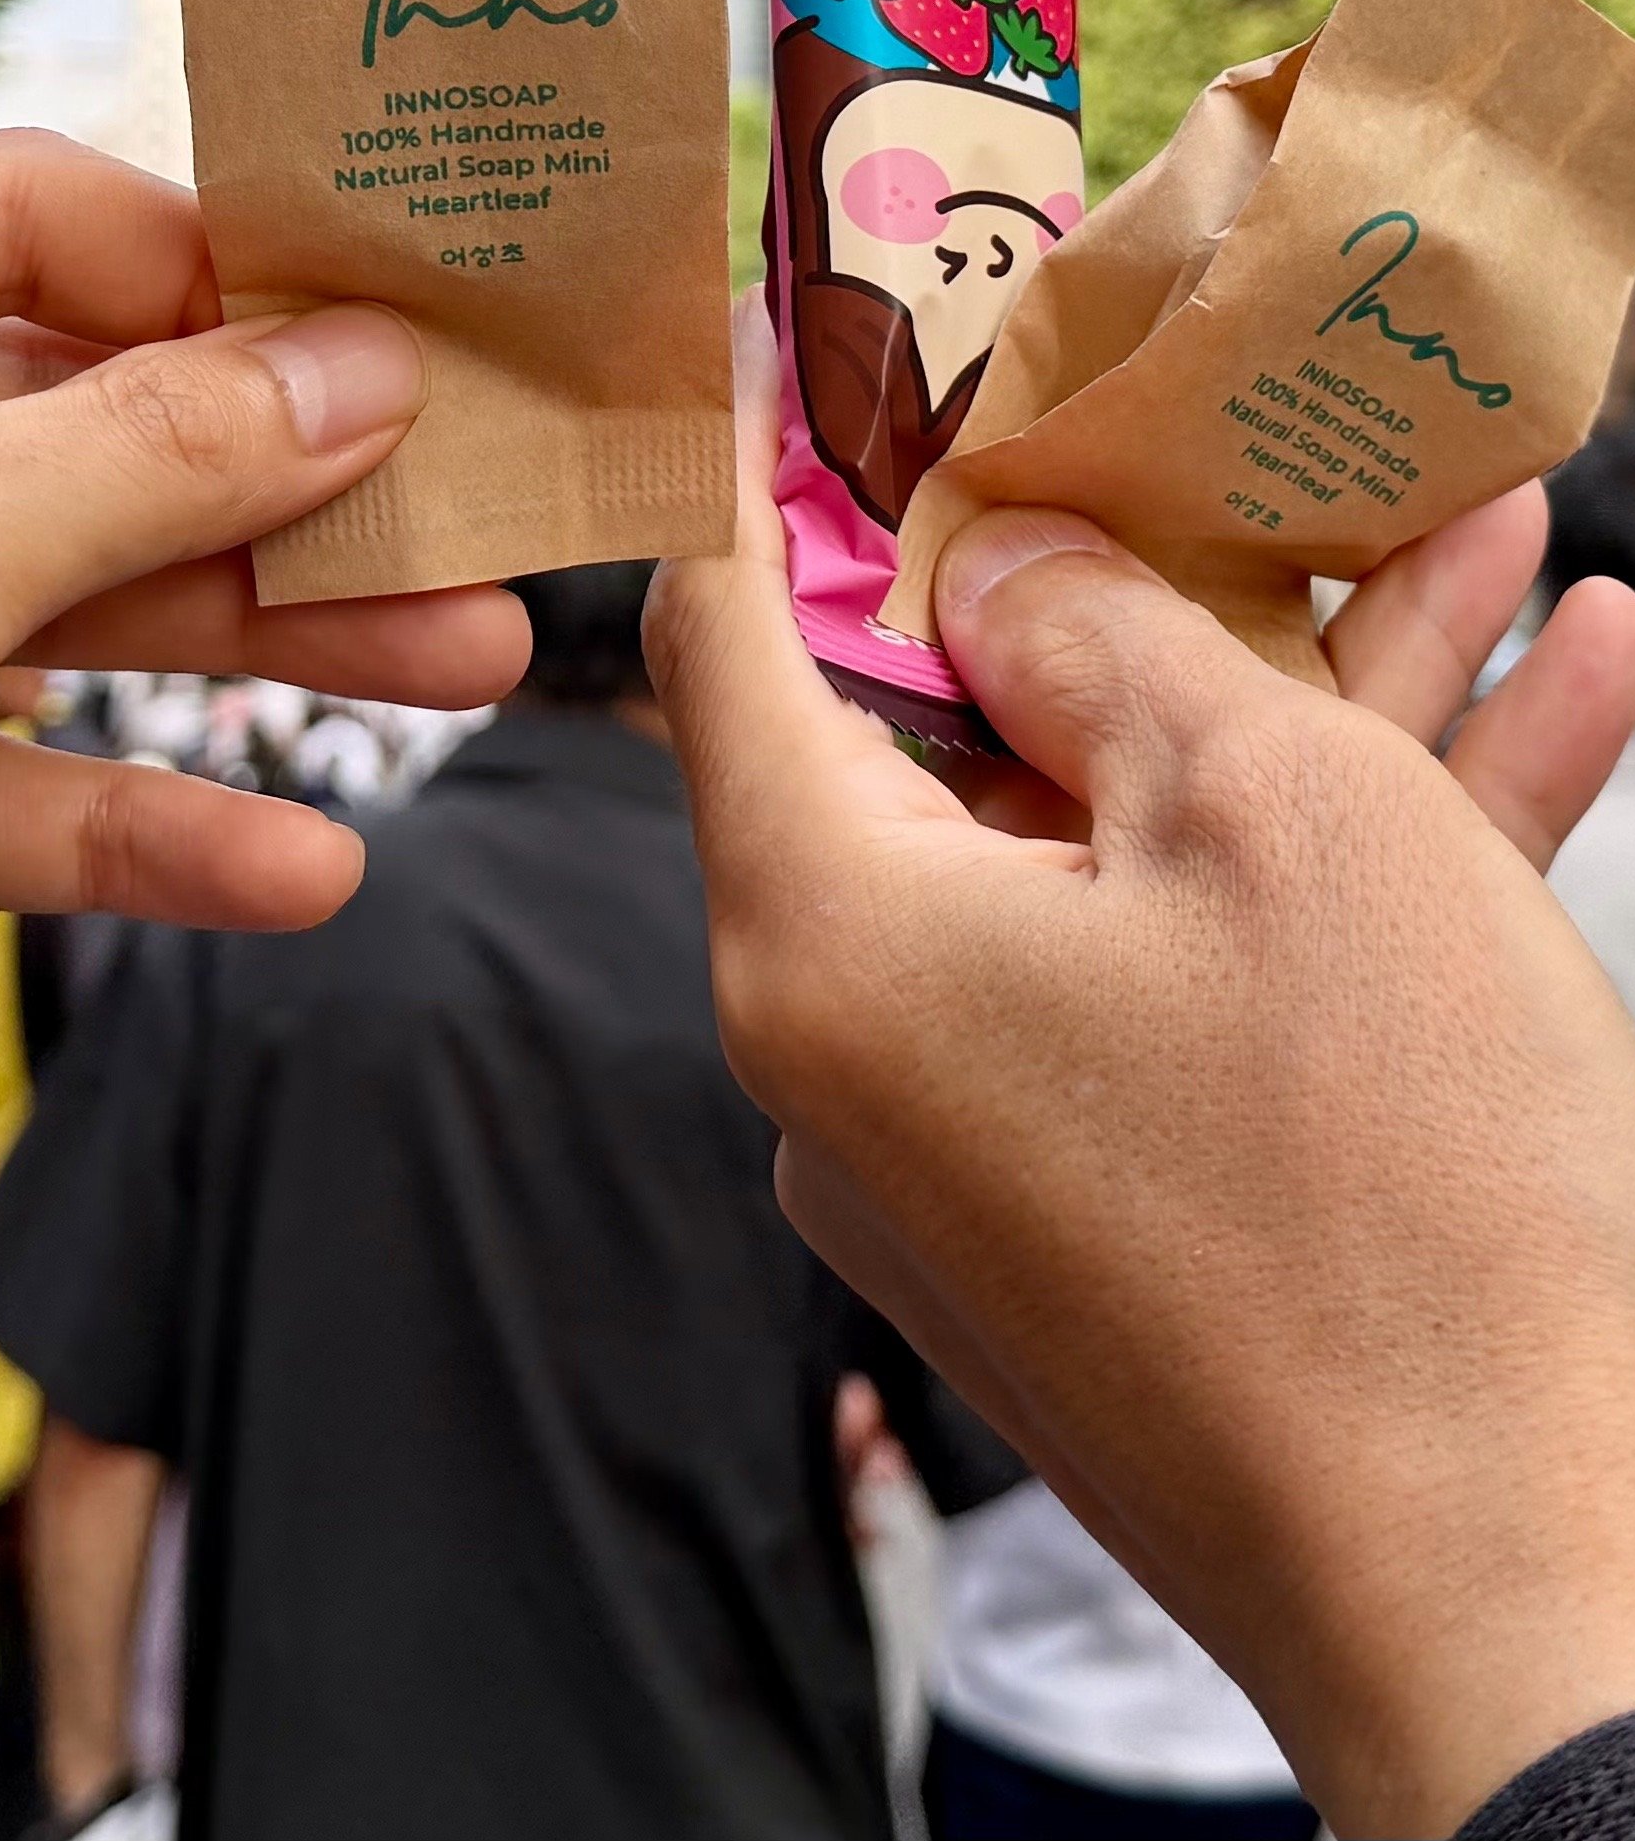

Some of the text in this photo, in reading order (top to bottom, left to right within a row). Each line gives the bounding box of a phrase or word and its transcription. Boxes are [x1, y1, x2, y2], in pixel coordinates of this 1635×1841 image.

[384, 83, 559, 115] INNOSOAP
[340, 115, 606, 156] 100% Handmade
[333, 148, 612, 192] Natural Soap Mini
[407, 185, 553, 219] Heartleaf
[439, 242, 527, 269] 어성초
[1314, 210, 1513, 410] Inno
[1294, 359, 1415, 435] INNOSOAP
[1250, 372, 1421, 483] 100% Handmade
[1220, 394, 1406, 508] Natural Soap Mini
[1239, 440, 1343, 505] Heartleaf
[1224, 490, 1285, 531] 어성초
